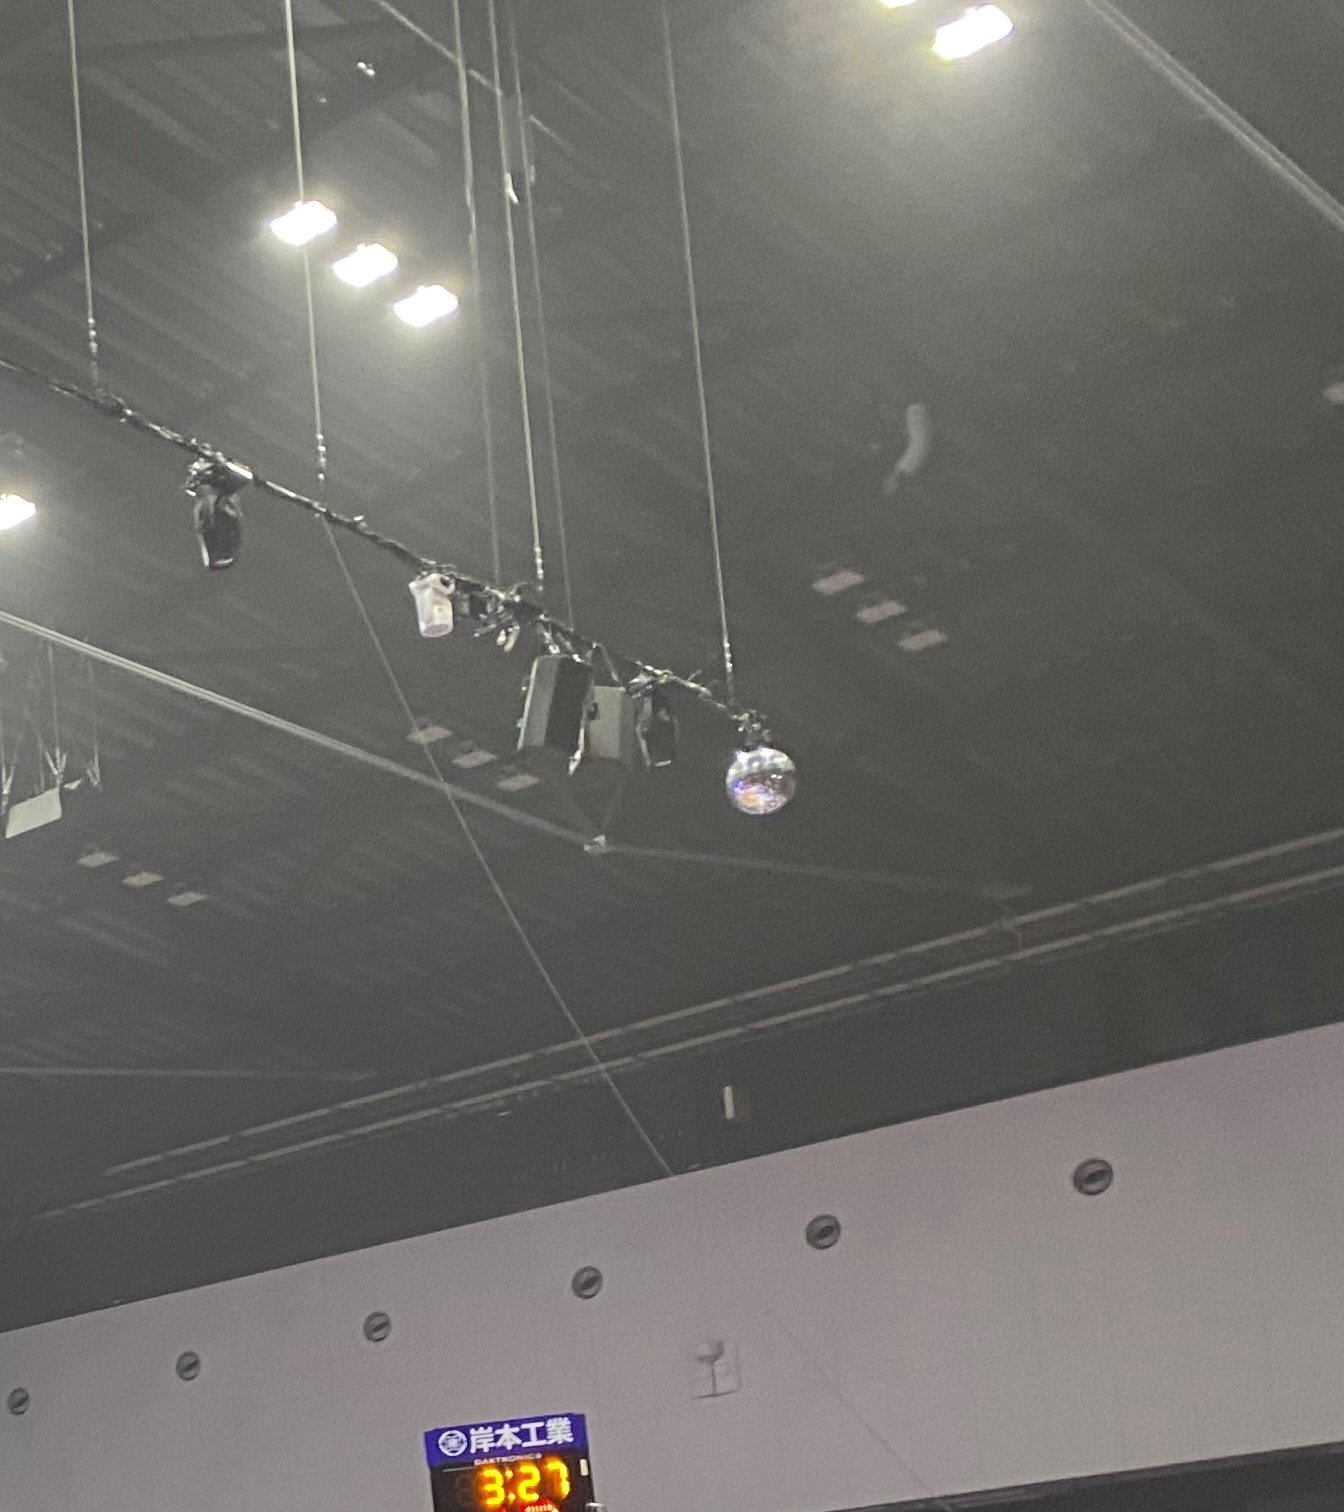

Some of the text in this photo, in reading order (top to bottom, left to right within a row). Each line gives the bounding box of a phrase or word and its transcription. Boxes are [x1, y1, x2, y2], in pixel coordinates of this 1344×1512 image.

[469, 1417, 574, 1453] 岸本工業
[482, 1460, 571, 1506] 3:27
